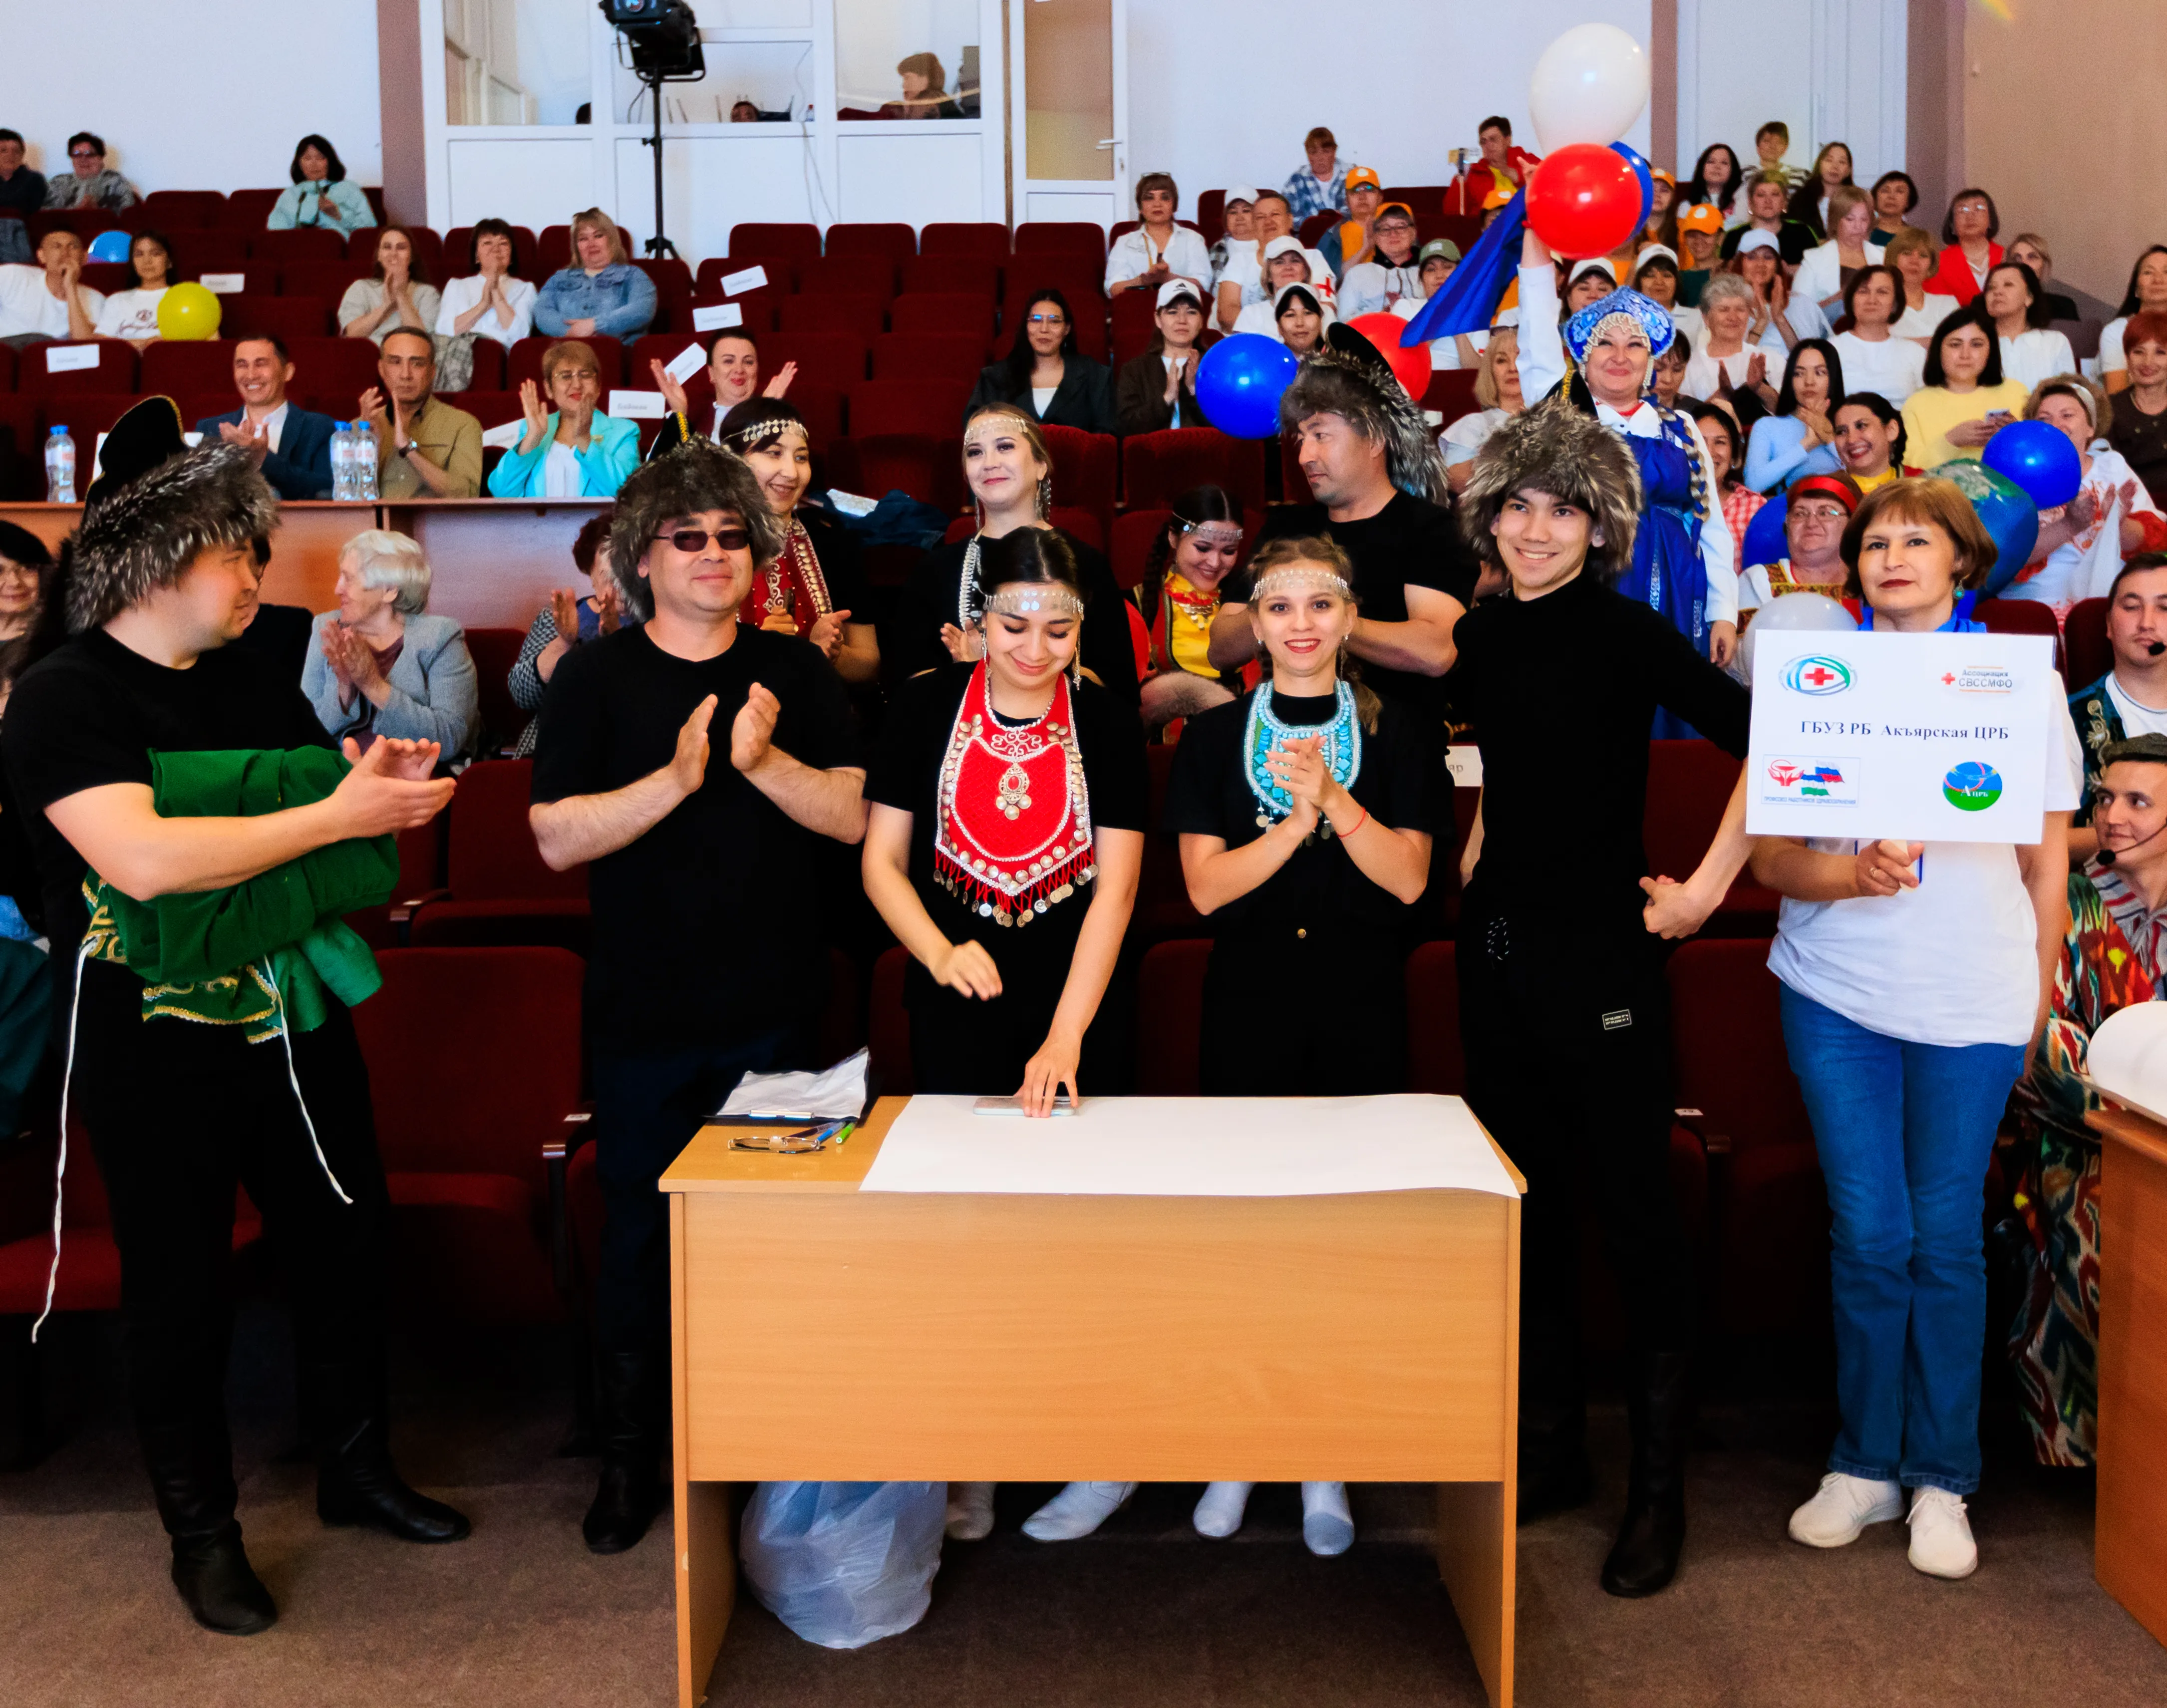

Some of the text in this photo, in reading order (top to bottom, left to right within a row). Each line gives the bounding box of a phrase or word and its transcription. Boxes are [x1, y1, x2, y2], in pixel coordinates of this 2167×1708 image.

[1959, 678, 2012, 688] СВССМФО
[1801, 721, 2009, 741] ГБУЗ РБ Акъярская ЦРБ
